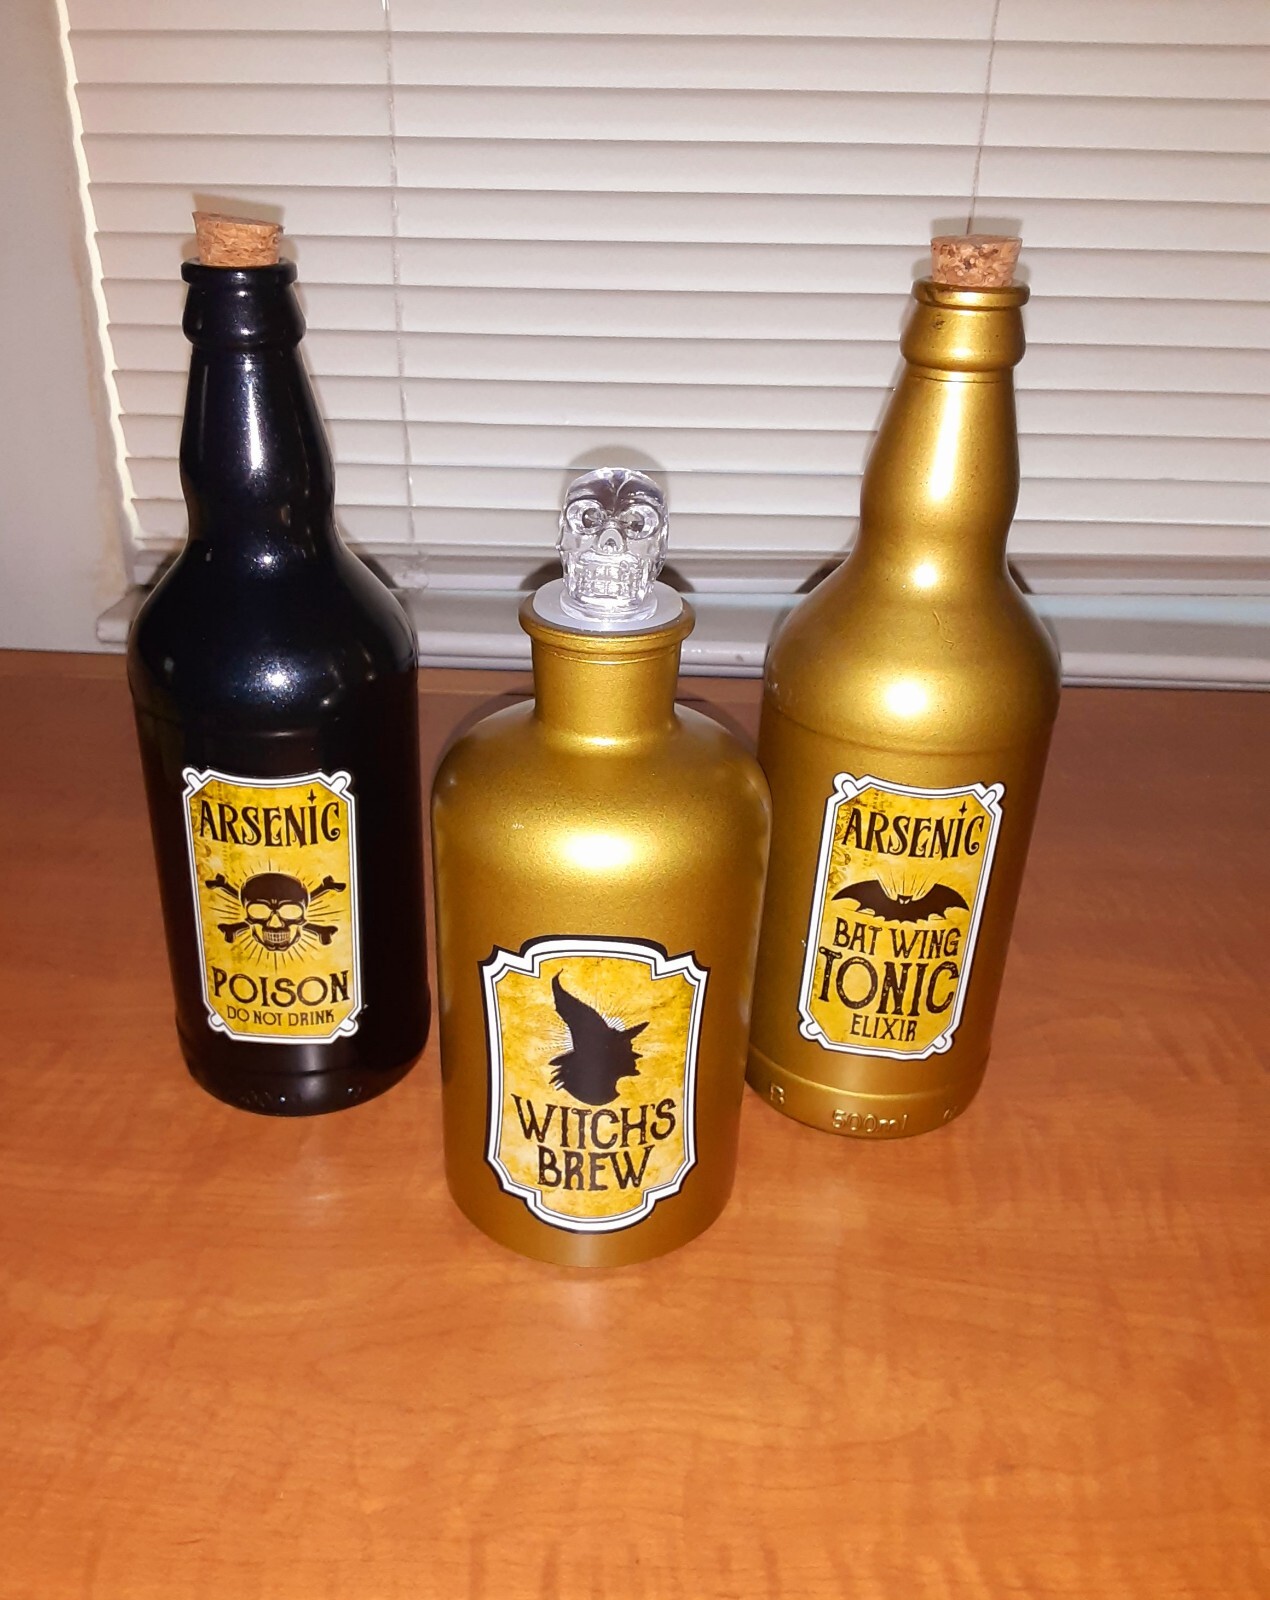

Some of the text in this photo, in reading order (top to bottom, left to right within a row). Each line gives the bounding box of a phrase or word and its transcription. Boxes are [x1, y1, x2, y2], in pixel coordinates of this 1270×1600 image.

[200, 789, 341, 848] ARSENIC
[842, 800, 985, 860] ARSENIC
[833, 917, 962, 960] BAT WING
[211, 966, 350, 1007] POISON
[818, 946, 960, 1016] TONIC
[226, 1005, 336, 1027] DO NOT DRINK
[850, 1014, 918, 1042] ELIXIR
[511, 1093, 677, 1149] WITCH'S
[537, 1144, 656, 1192] BREW
